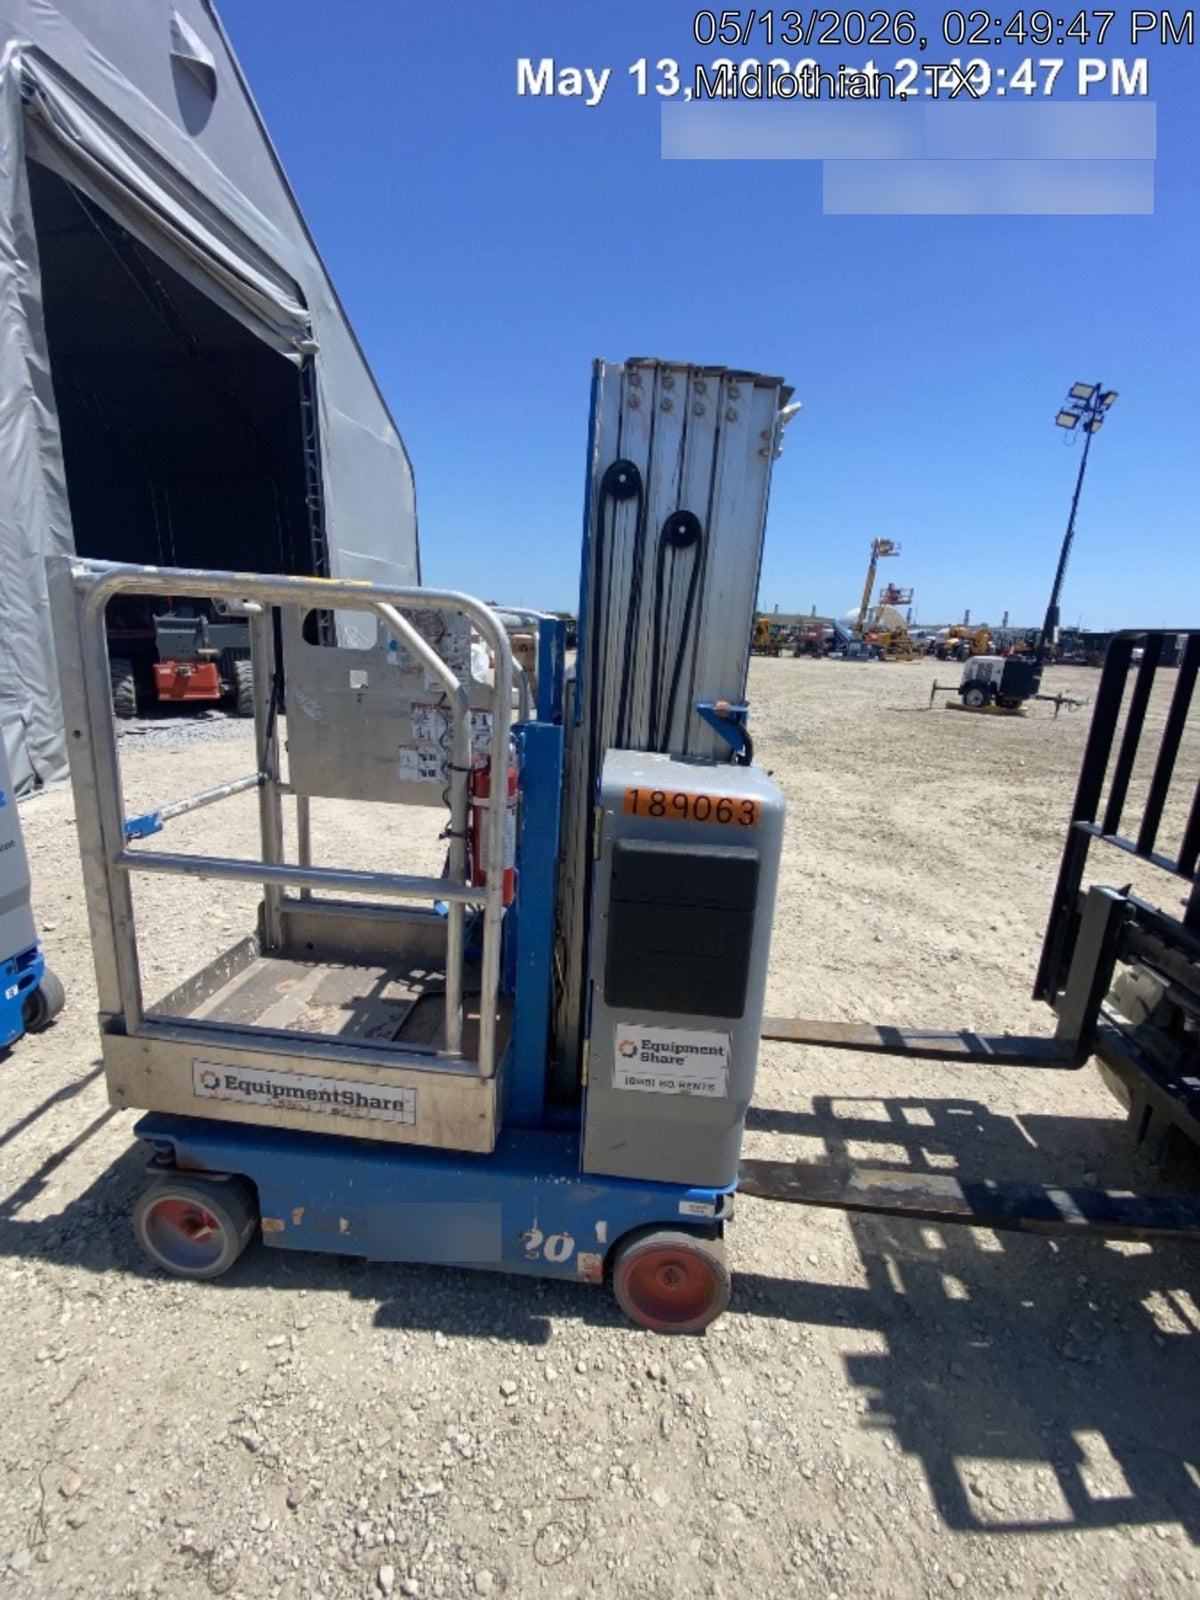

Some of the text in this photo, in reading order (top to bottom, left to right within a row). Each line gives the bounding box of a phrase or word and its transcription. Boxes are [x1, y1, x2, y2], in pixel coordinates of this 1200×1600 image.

[629, 788, 755, 827] 189063
[640, 1051, 686, 1066] Share
[641, 1039, 724, 1057] Equipment
[224, 1074, 405, 1112] EquipmentShare
